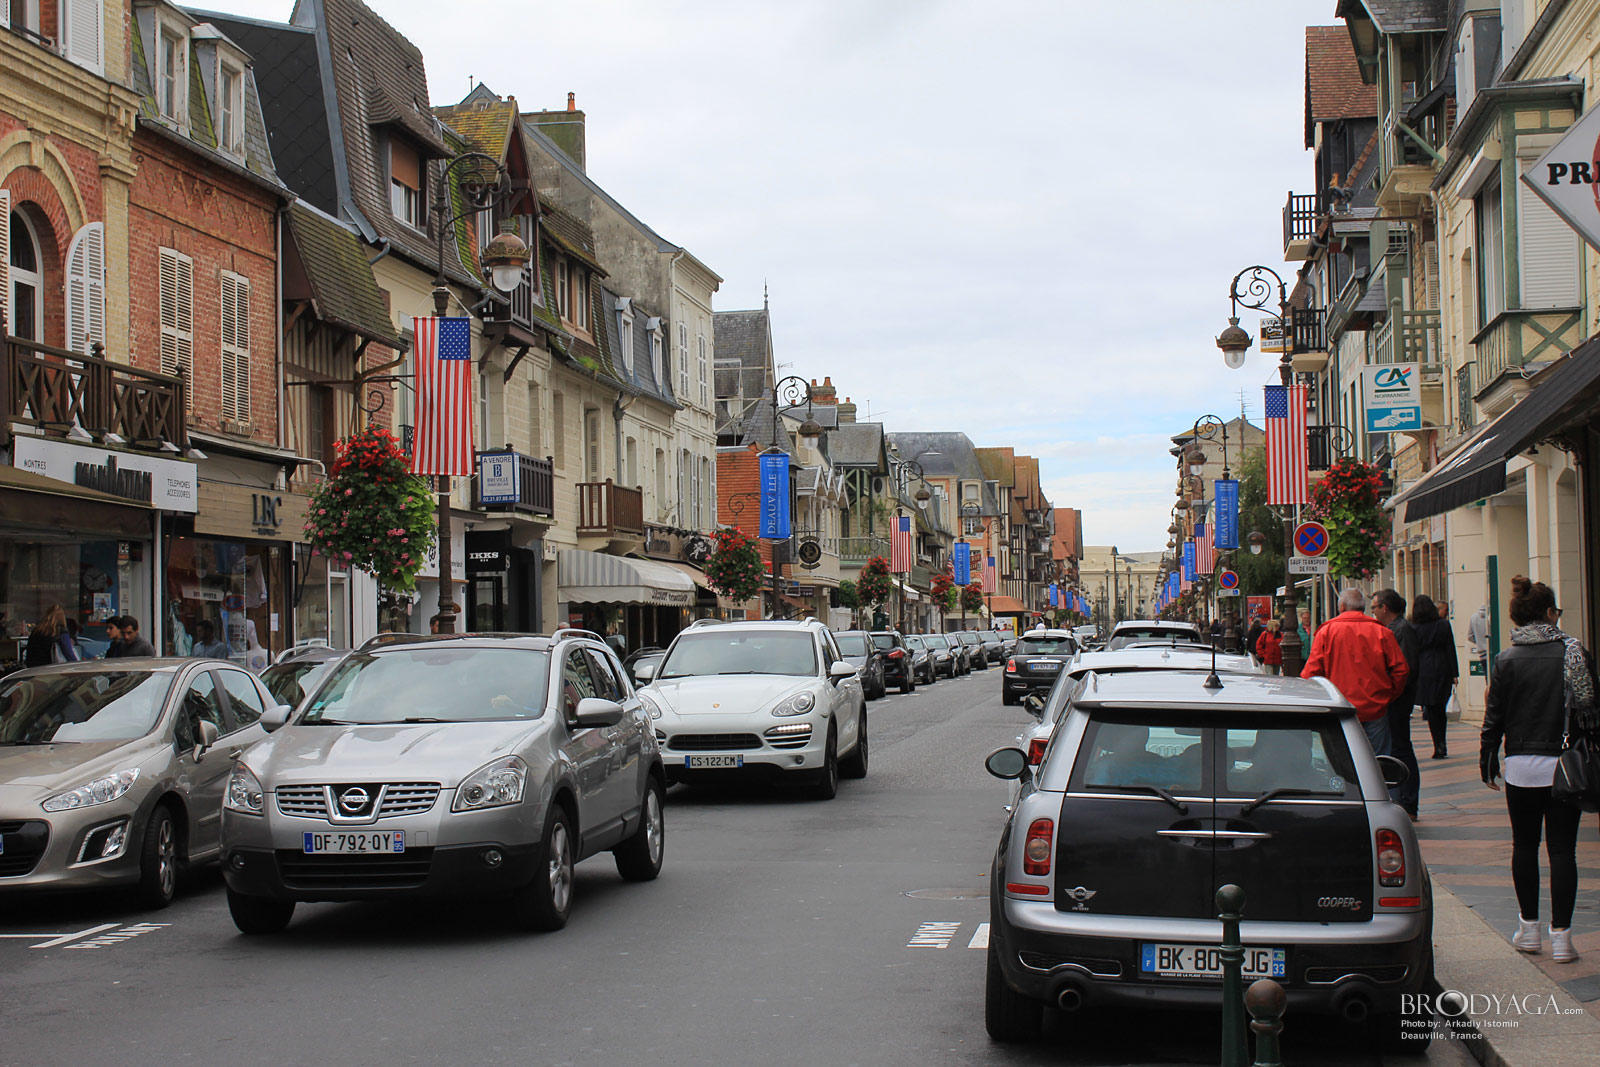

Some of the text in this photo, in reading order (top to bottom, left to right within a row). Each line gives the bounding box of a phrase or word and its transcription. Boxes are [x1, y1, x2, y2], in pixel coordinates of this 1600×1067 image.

[1374, 367, 1412, 388] CA
[24, 459, 47, 471] MONTRES
[488, 456, 511, 464] VENDRE
[167, 478, 191, 489] TELEPHONES
[166, 489, 191, 499] ACCESSOIRES
[252, 493, 283, 527] LBC
[469, 551, 499, 559] IKKS
[691, 756, 736, 767] CS-122-CM
[1317, 896, 1355, 908] COOPER
[1273, 963, 1285, 975] 33
